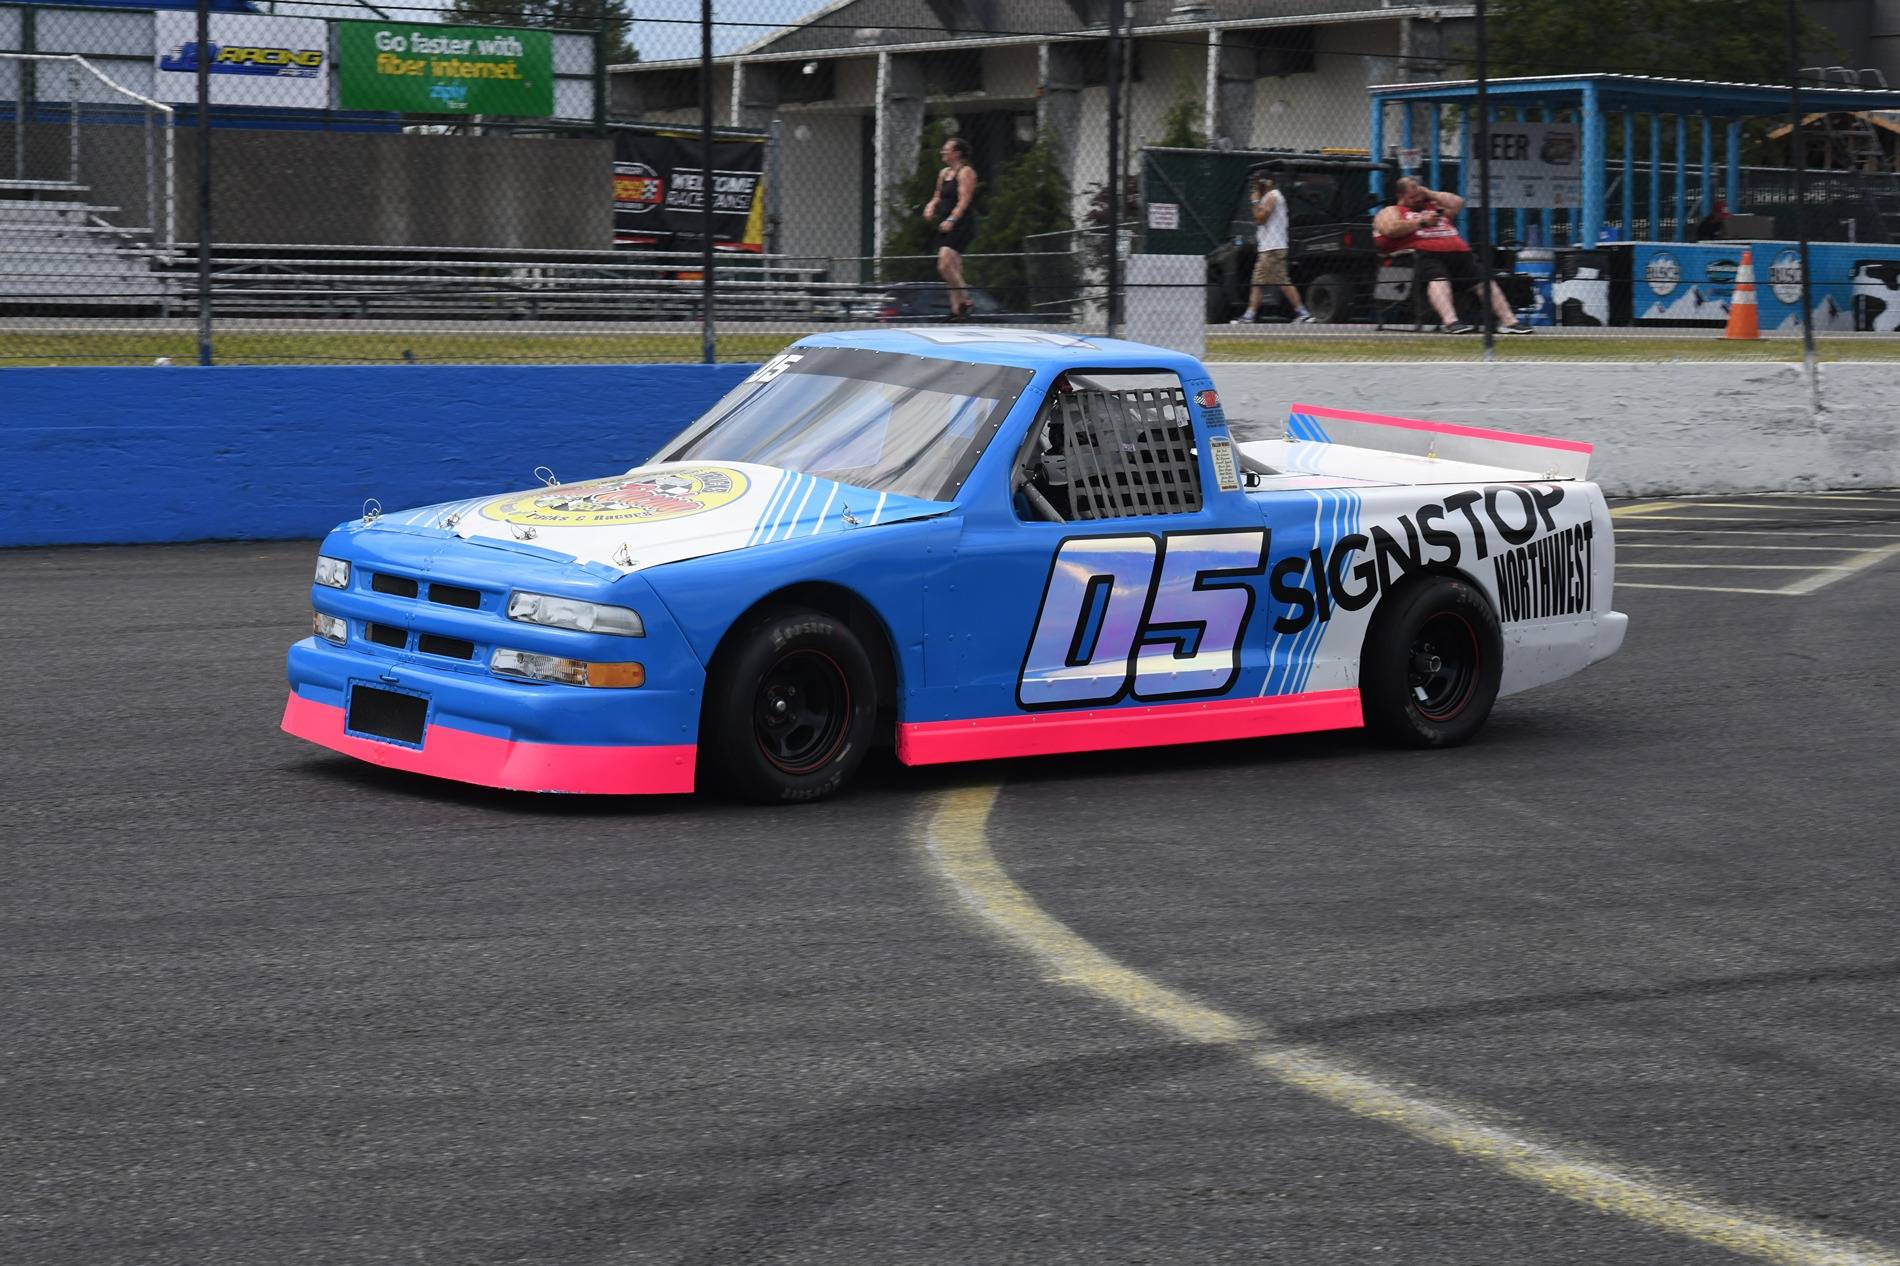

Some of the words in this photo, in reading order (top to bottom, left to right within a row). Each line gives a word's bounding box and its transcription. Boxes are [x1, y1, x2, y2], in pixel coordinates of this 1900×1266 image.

[217, 46, 322, 68] RACING
[375, 31, 408, 52] Go
[411, 32, 473, 55] faster
[477, 35, 523, 57] with
[376, 53, 427, 76] fiber
[431, 57, 524, 80] internet.
[671, 174, 756, 193] WELOME
[745, 354, 804, 384] 05
[1269, 484, 1565, 635] SIGNSTOP
[1493, 520, 1594, 623] NORTHWEST
[1015, 526, 1272, 713] 05
